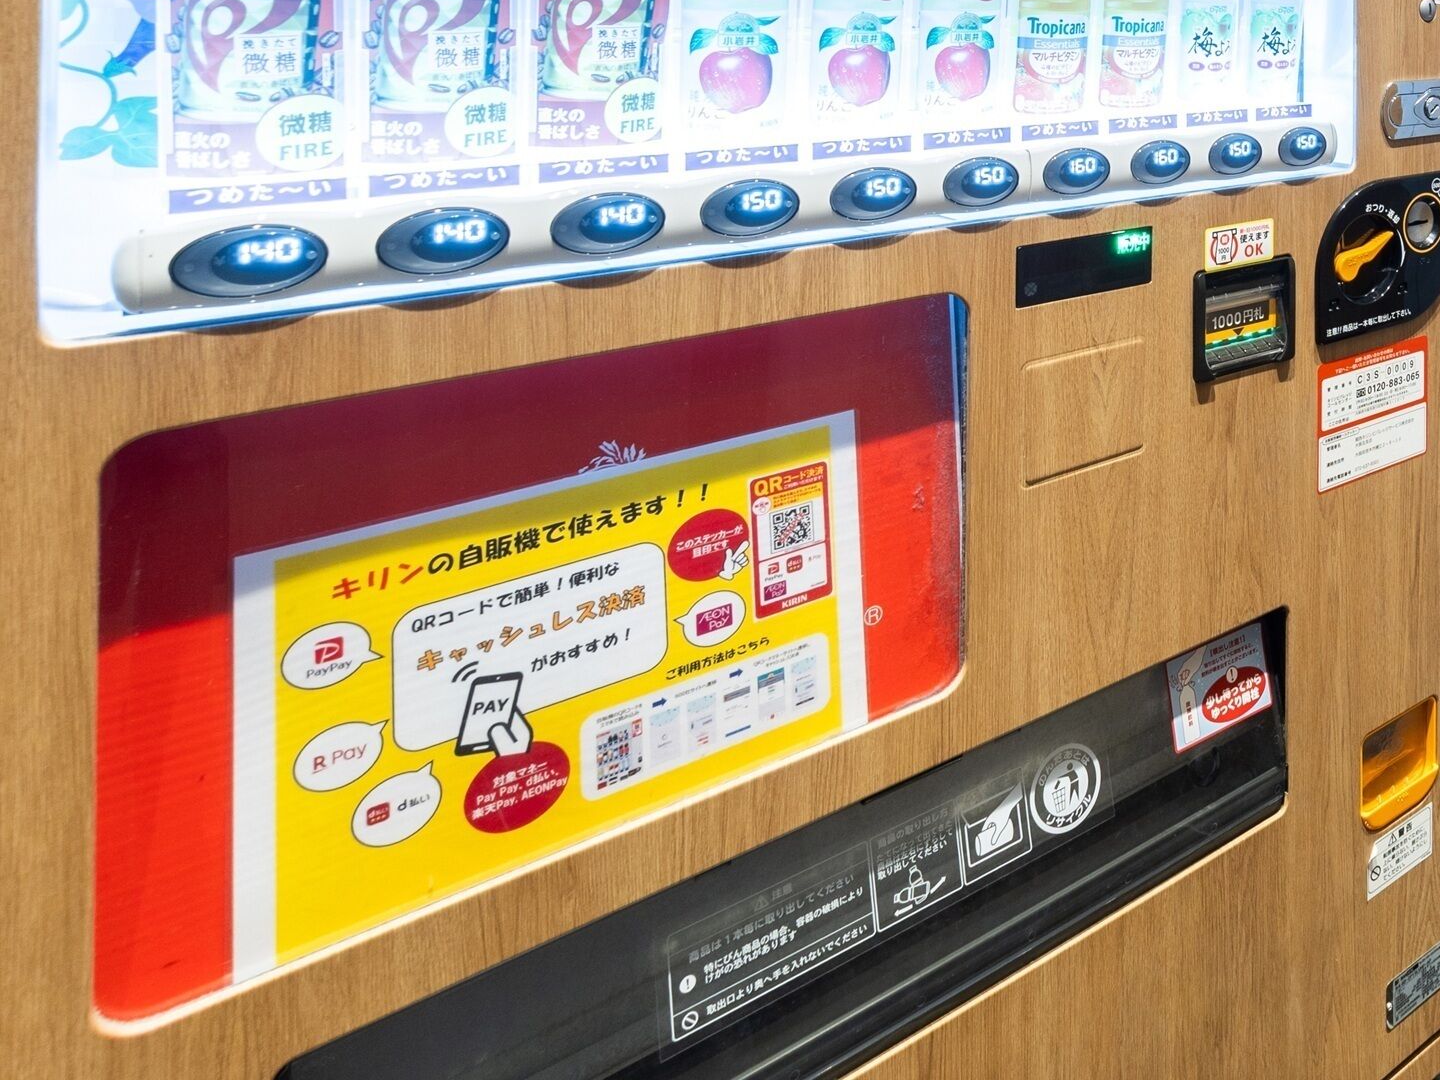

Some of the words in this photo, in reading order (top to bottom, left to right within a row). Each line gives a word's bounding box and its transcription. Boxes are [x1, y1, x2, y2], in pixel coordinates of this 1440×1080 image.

[1026, 16, 1086, 36] Tropicana
[1111, 15, 1165, 35] Tropicana
[241, 36, 297, 51] 挽きたて
[722, 35, 757, 48] 小岩井
[850, 32, 878, 45] 小岩井
[954, 31, 981, 43] 小岩井
[1033, 38, 1081, 50] Essentials
[1117, 36, 1161, 48] Essentials
[242, 49, 297, 76] 微糖
[1032, 49, 1080, 62] マルチビタミン
[1115, 47, 1159, 61] マルチビタミン
[620, 91, 656, 113] 微糖
[278, 110, 333, 138] 微糖
[464, 102, 508, 127] 微糖
[619, 117, 656, 134] FIRE
[278, 140, 335, 162] FIRE
[1229, 141, 1251, 156] 150
[974, 166, 1004, 184] 150
[1069, 157, 1096, 174] 160
[865, 178, 901, 197] 150
[742, 190, 782, 211] 150
[600, 203, 645, 226] 140
[433, 219, 488, 244] 140
[1239, 230, 1270, 244] 使えます
[237, 237, 302, 265] 140
[1217, 246, 1230, 255] 1000
[1244, 242, 1264, 258] OK
[1211, 306, 1265, 331] 1000円札
[1367, 370, 1420, 395] 0120-883-065
[332, 483, 709, 600] キリンの自販機で使えます!!
[675, 523, 744, 552] このステッカーが
[692, 539, 729, 559] 目印です
[782, 594, 808, 610] KIRIN
[416, 584, 647, 672] キャッシュレス決済
[709, 614, 731, 632] Pay
[531, 627, 632, 673] がおすすめ!
[665, 636, 771, 681] ご利用方法はこちら
[306, 660, 353, 679] PayPay
[1205, 673, 1262, 710] 少し待ってから
[472, 698, 509, 716] PAY
[1210, 686, 1261, 720] ゆっくり開栓
[331, 744, 368, 765] Pay
[1037, 748, 1090, 789] のんだあとは
[1044, 790, 1092, 829] リサイクル
[876, 839, 949, 881] 取り出してください
[705, 923, 869, 1016] 取出口より奥へ手を入れないでください
